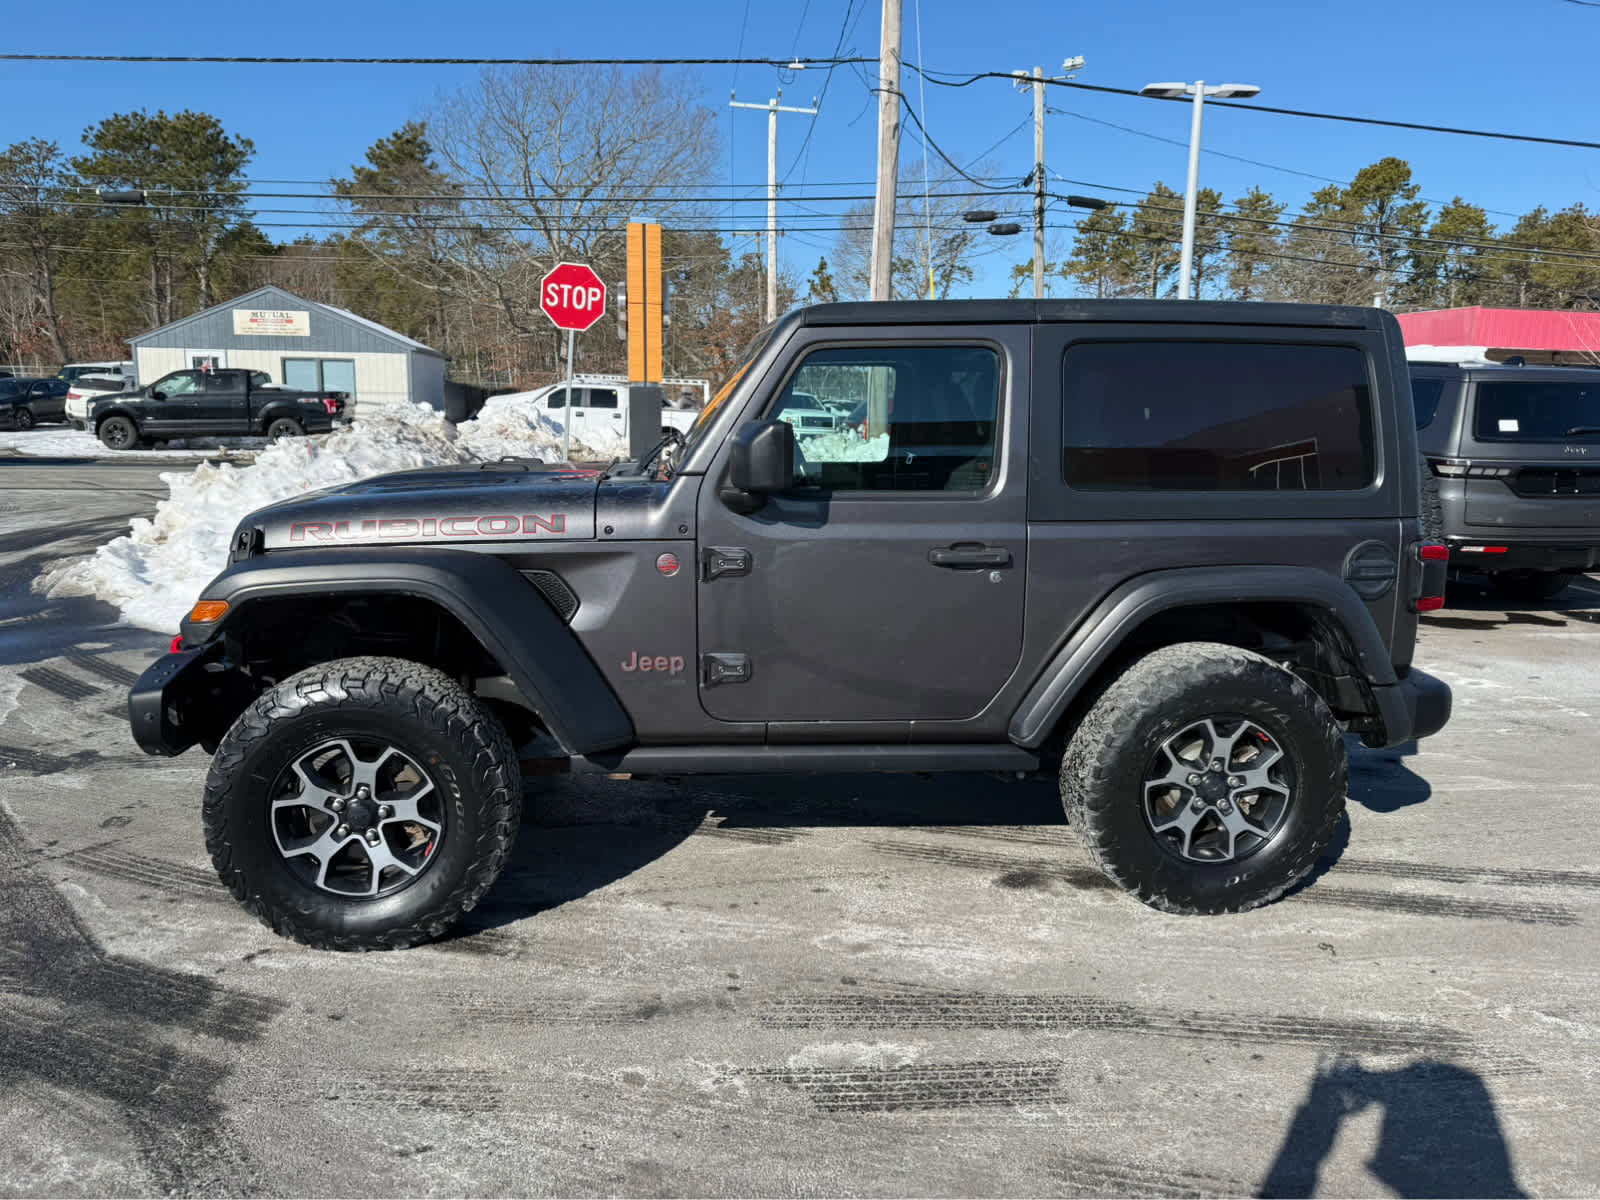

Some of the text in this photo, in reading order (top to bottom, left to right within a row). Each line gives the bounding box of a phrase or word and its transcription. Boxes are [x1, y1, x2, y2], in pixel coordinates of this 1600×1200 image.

[545, 282, 601, 311] STOP
[290, 513, 566, 542] RUBICON
[621, 651, 685, 675] Jeep
